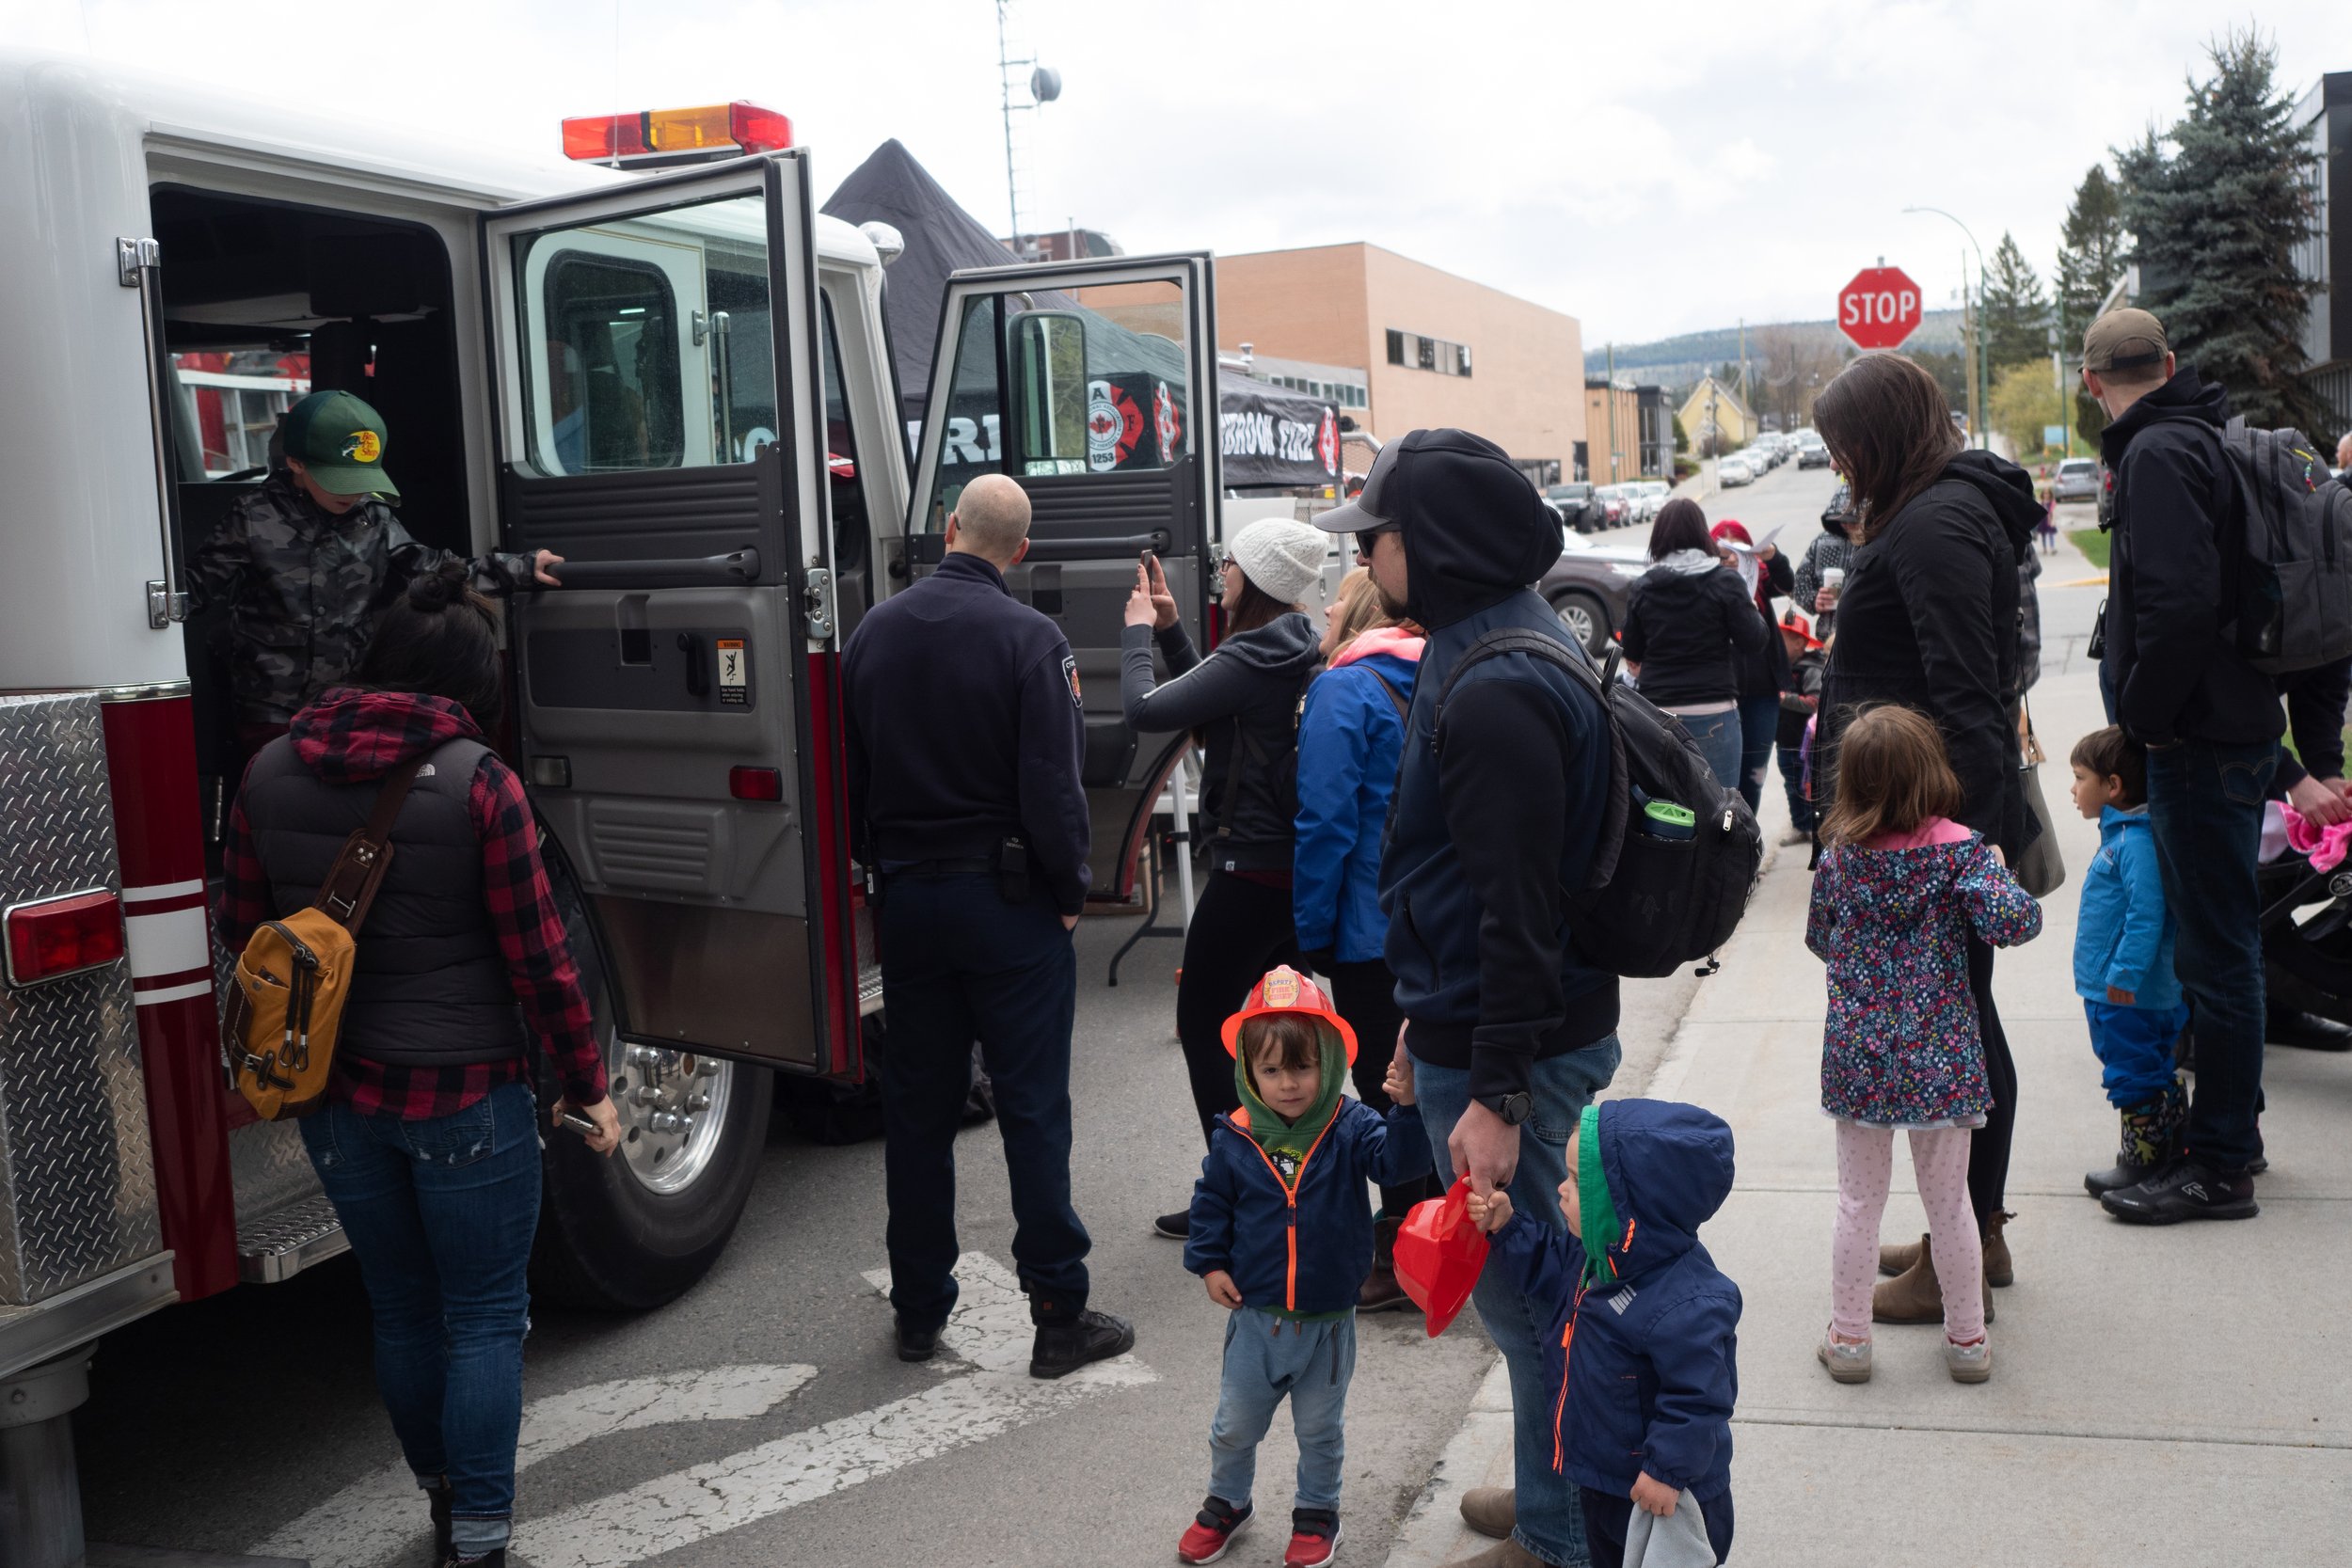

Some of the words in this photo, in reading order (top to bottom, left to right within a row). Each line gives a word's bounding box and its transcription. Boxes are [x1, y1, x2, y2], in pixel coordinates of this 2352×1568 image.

[1845, 291, 1915, 325] STOP
[1091, 388, 1107, 401] A
[1127, 414, 1136, 432] F
[1220, 411, 1276, 455] BROOK
[1279, 419, 1316, 461] FIRE
[1091, 452, 1115, 464] 1253
